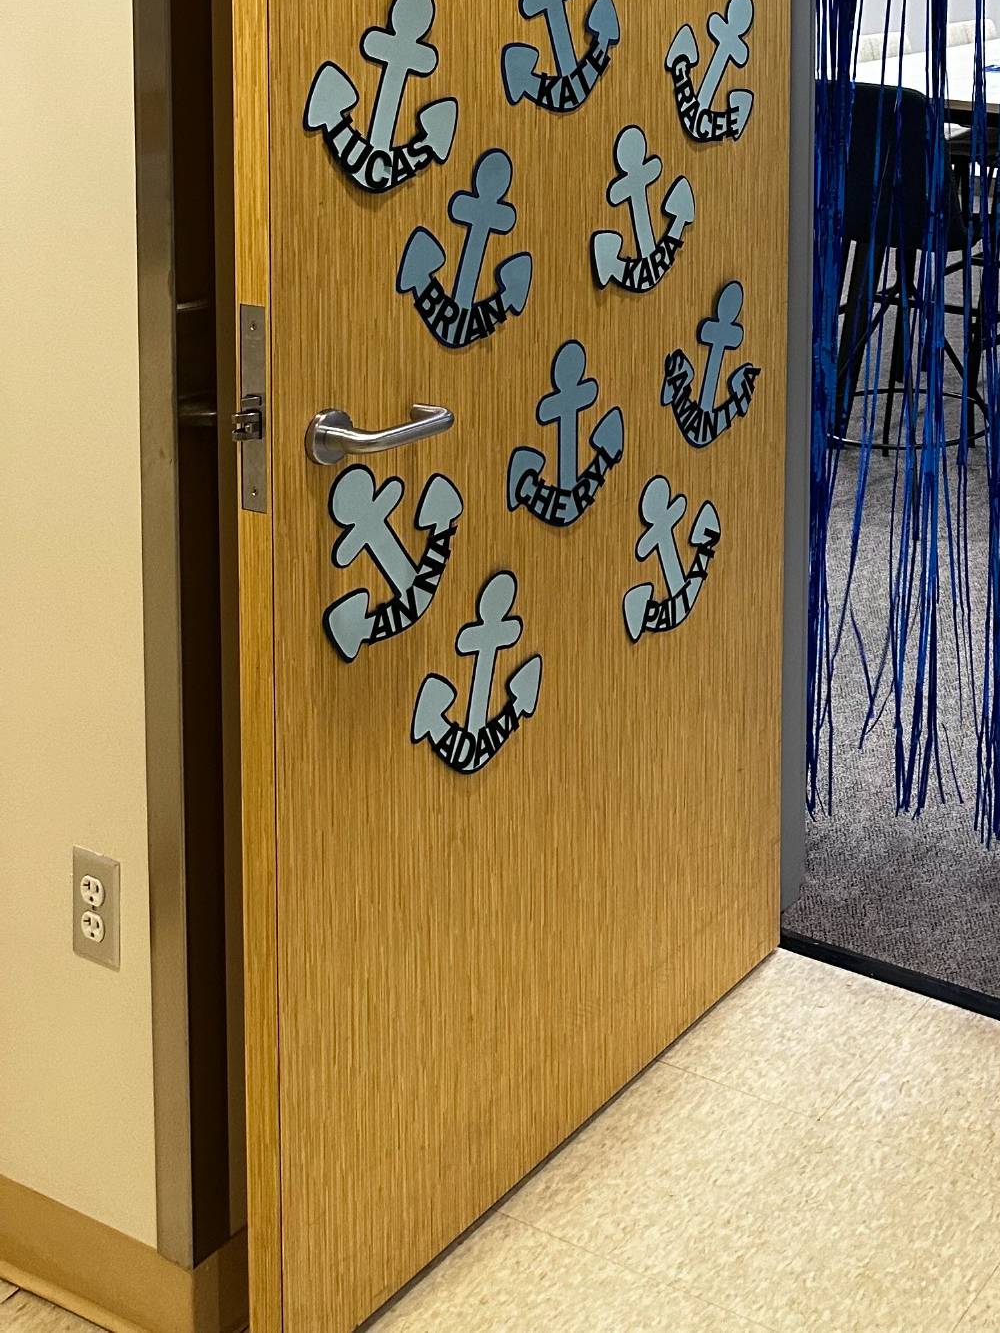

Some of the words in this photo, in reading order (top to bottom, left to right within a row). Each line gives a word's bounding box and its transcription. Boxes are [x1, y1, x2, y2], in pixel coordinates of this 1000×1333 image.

[536, 40, 611, 111] KATE
[672, 54, 740, 141] GRACEE
[327, 114, 434, 190] LUCAS
[621, 235, 685, 292] KARA
[414, 277, 508, 347] BRIAN
[665, 349, 761, 442] SAMANTHA
[515, 446, 622, 525] CHERYL
[368, 525, 458, 645] ANNA
[641, 527, 719, 632] PAITYN
[433, 701, 520, 771] ADAM
